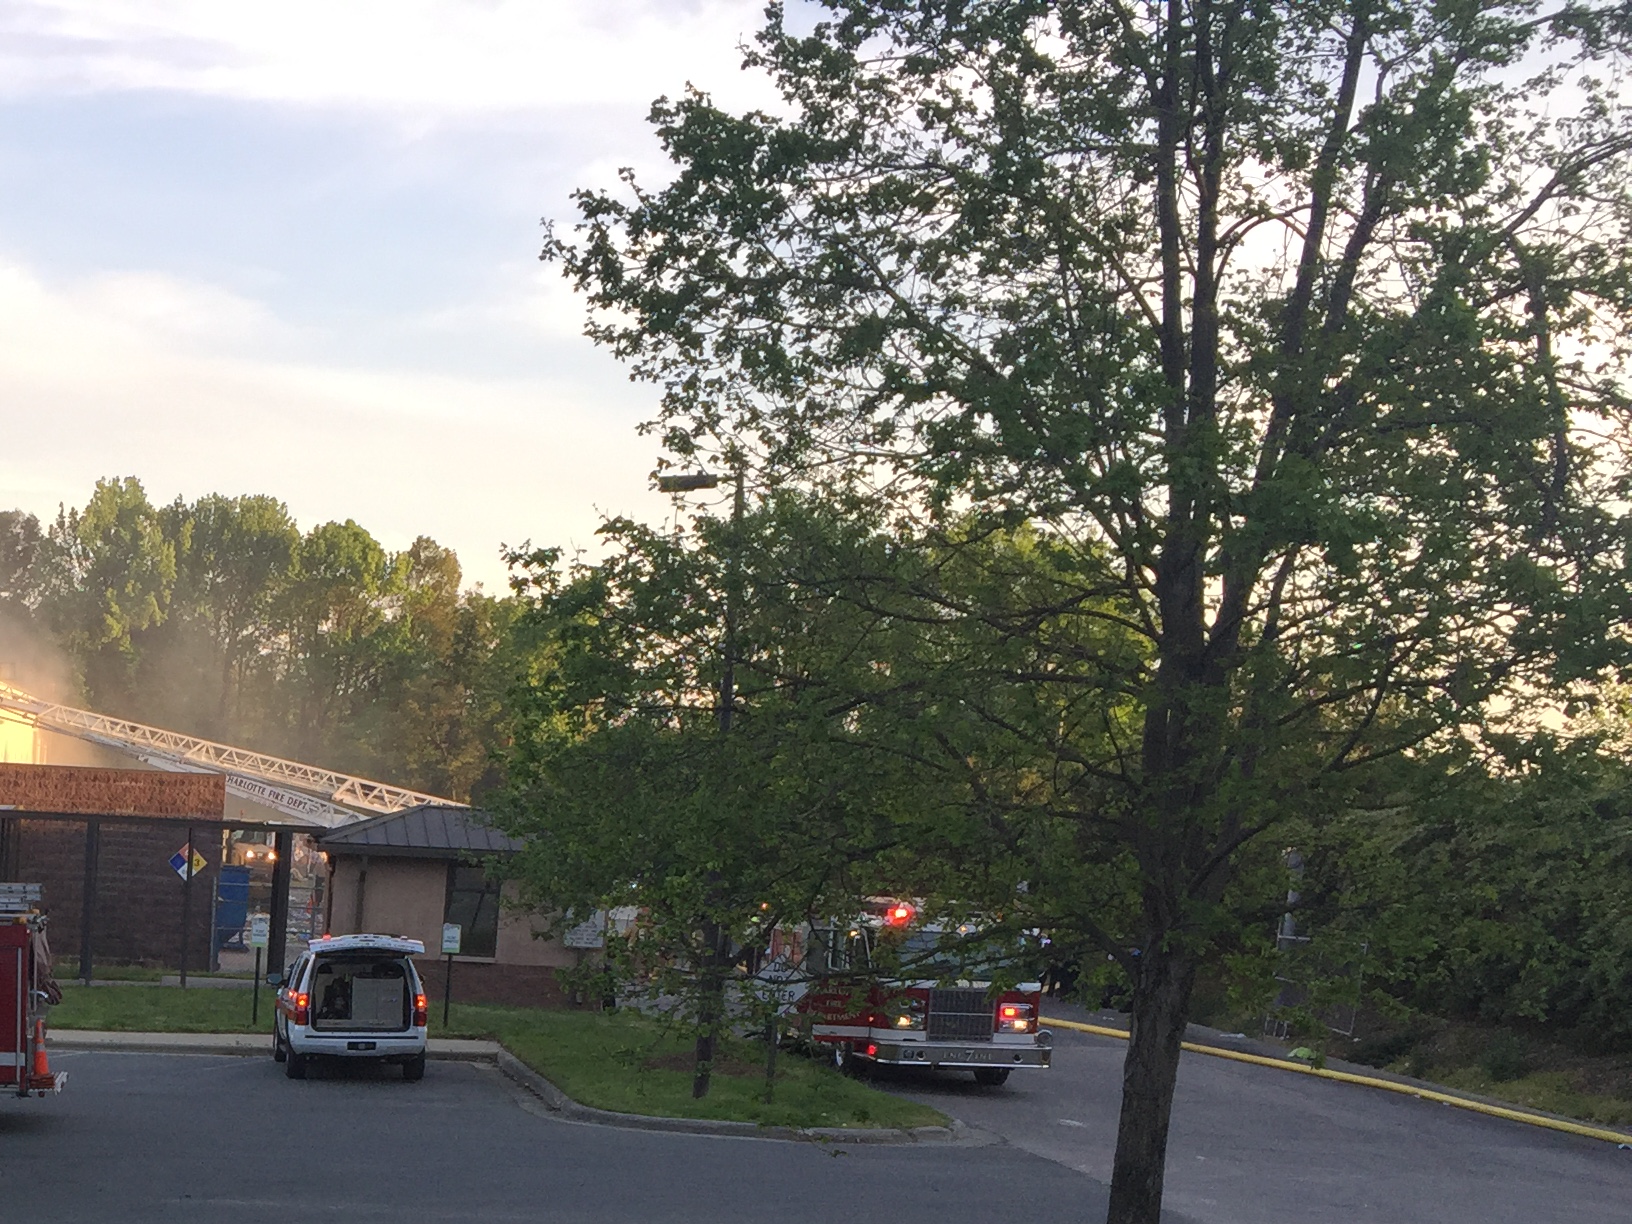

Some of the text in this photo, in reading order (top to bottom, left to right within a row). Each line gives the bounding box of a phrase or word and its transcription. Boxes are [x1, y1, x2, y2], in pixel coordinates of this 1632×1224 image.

[226, 774, 267, 796] HARLOTTE
[268, 789, 286, 803] FIRE
[193, 858, 201, 867] 3
[964, 1050, 975, 1062] 7
